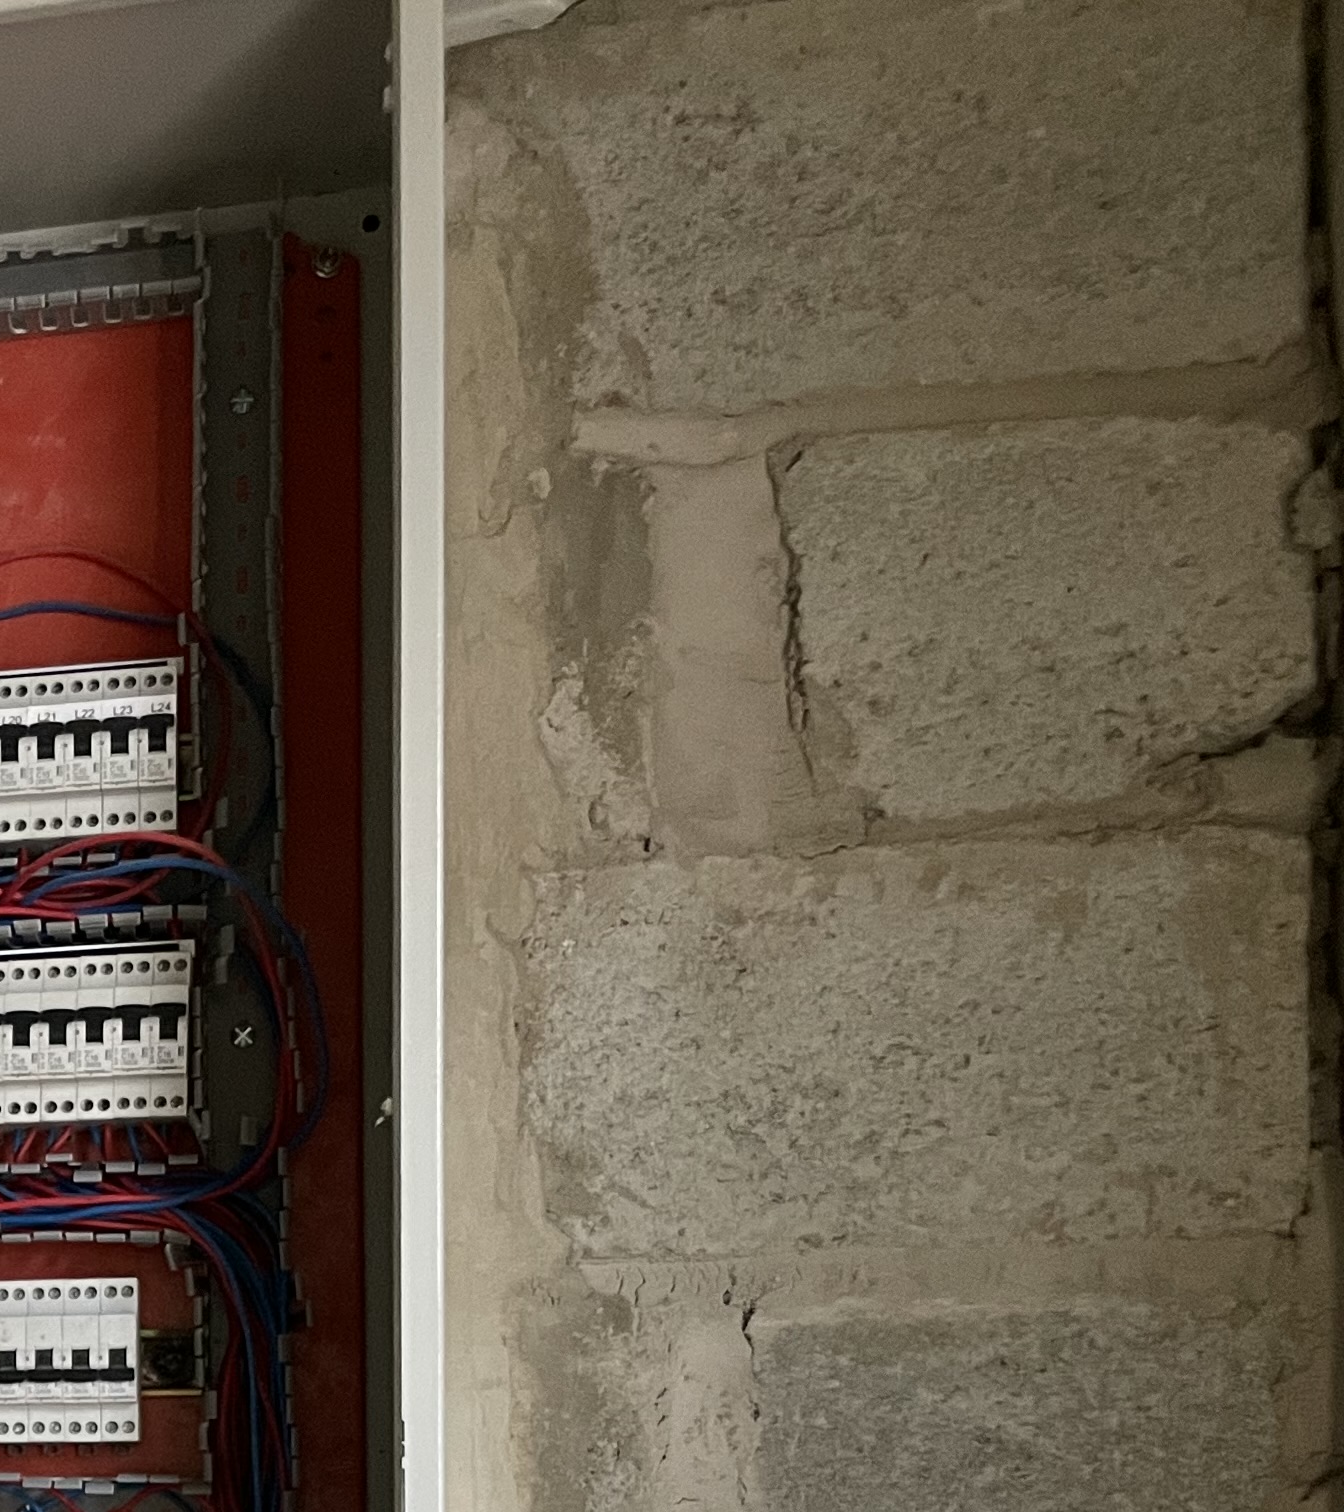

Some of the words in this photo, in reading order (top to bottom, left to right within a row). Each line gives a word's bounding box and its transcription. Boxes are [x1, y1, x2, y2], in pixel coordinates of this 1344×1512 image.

[112, 705, 133, 716] L23
[150, 701, 171, 713] L24
[37, 711, 56, 722] L21
[74, 708, 95, 719] L22
